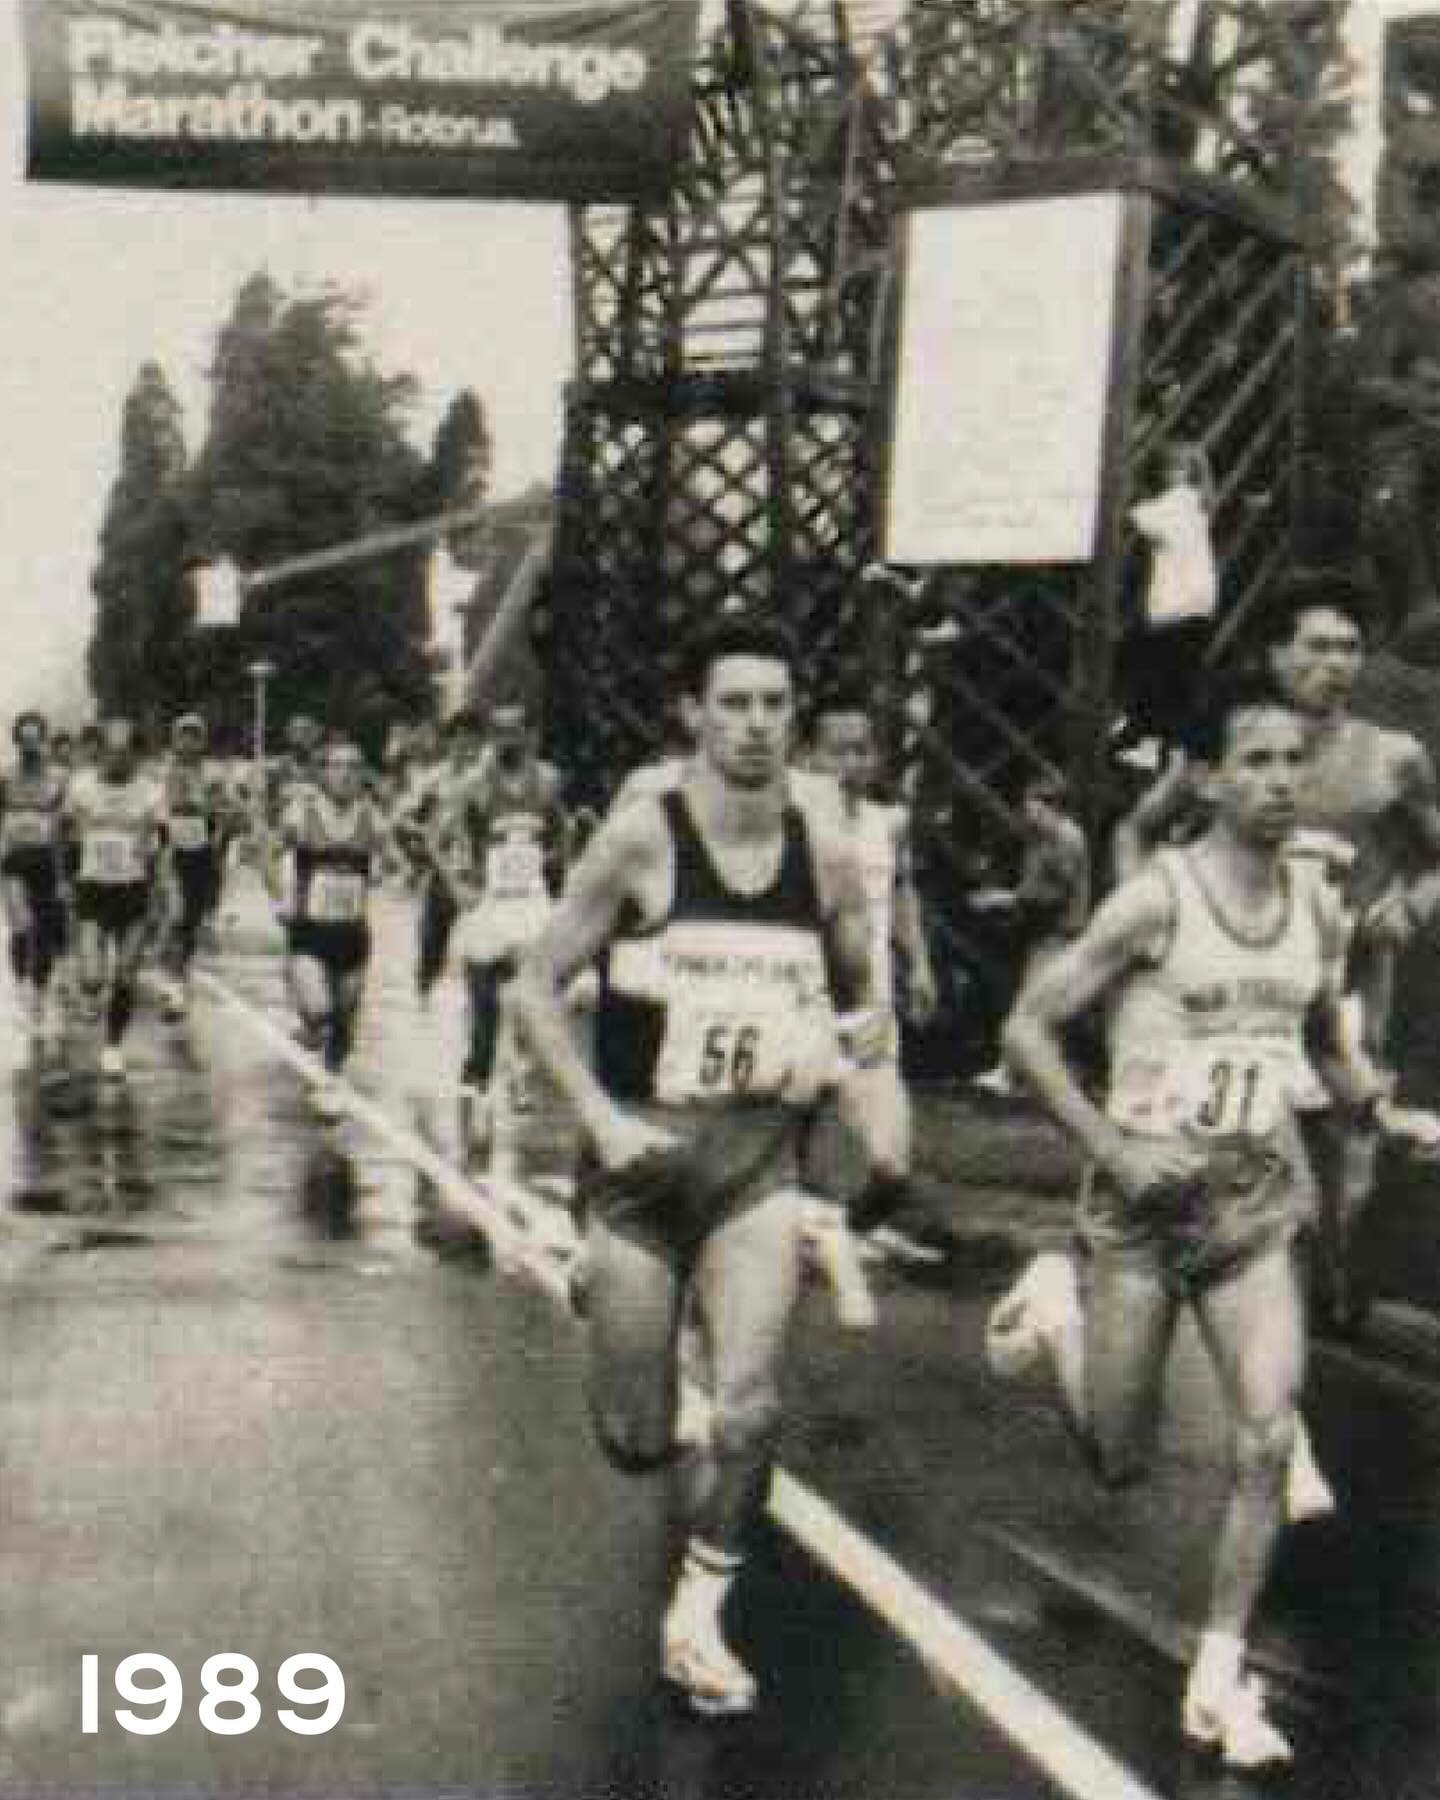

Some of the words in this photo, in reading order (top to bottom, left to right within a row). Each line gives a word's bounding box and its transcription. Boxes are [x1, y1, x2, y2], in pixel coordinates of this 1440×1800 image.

[69, 20, 322, 79] Fletcher
[350, 22, 647, 103] Challenge
[72, 80, 362, 139] Marathon
[699, 1022, 760, 1091] 56
[1197, 1060, 1262, 1128] 31
